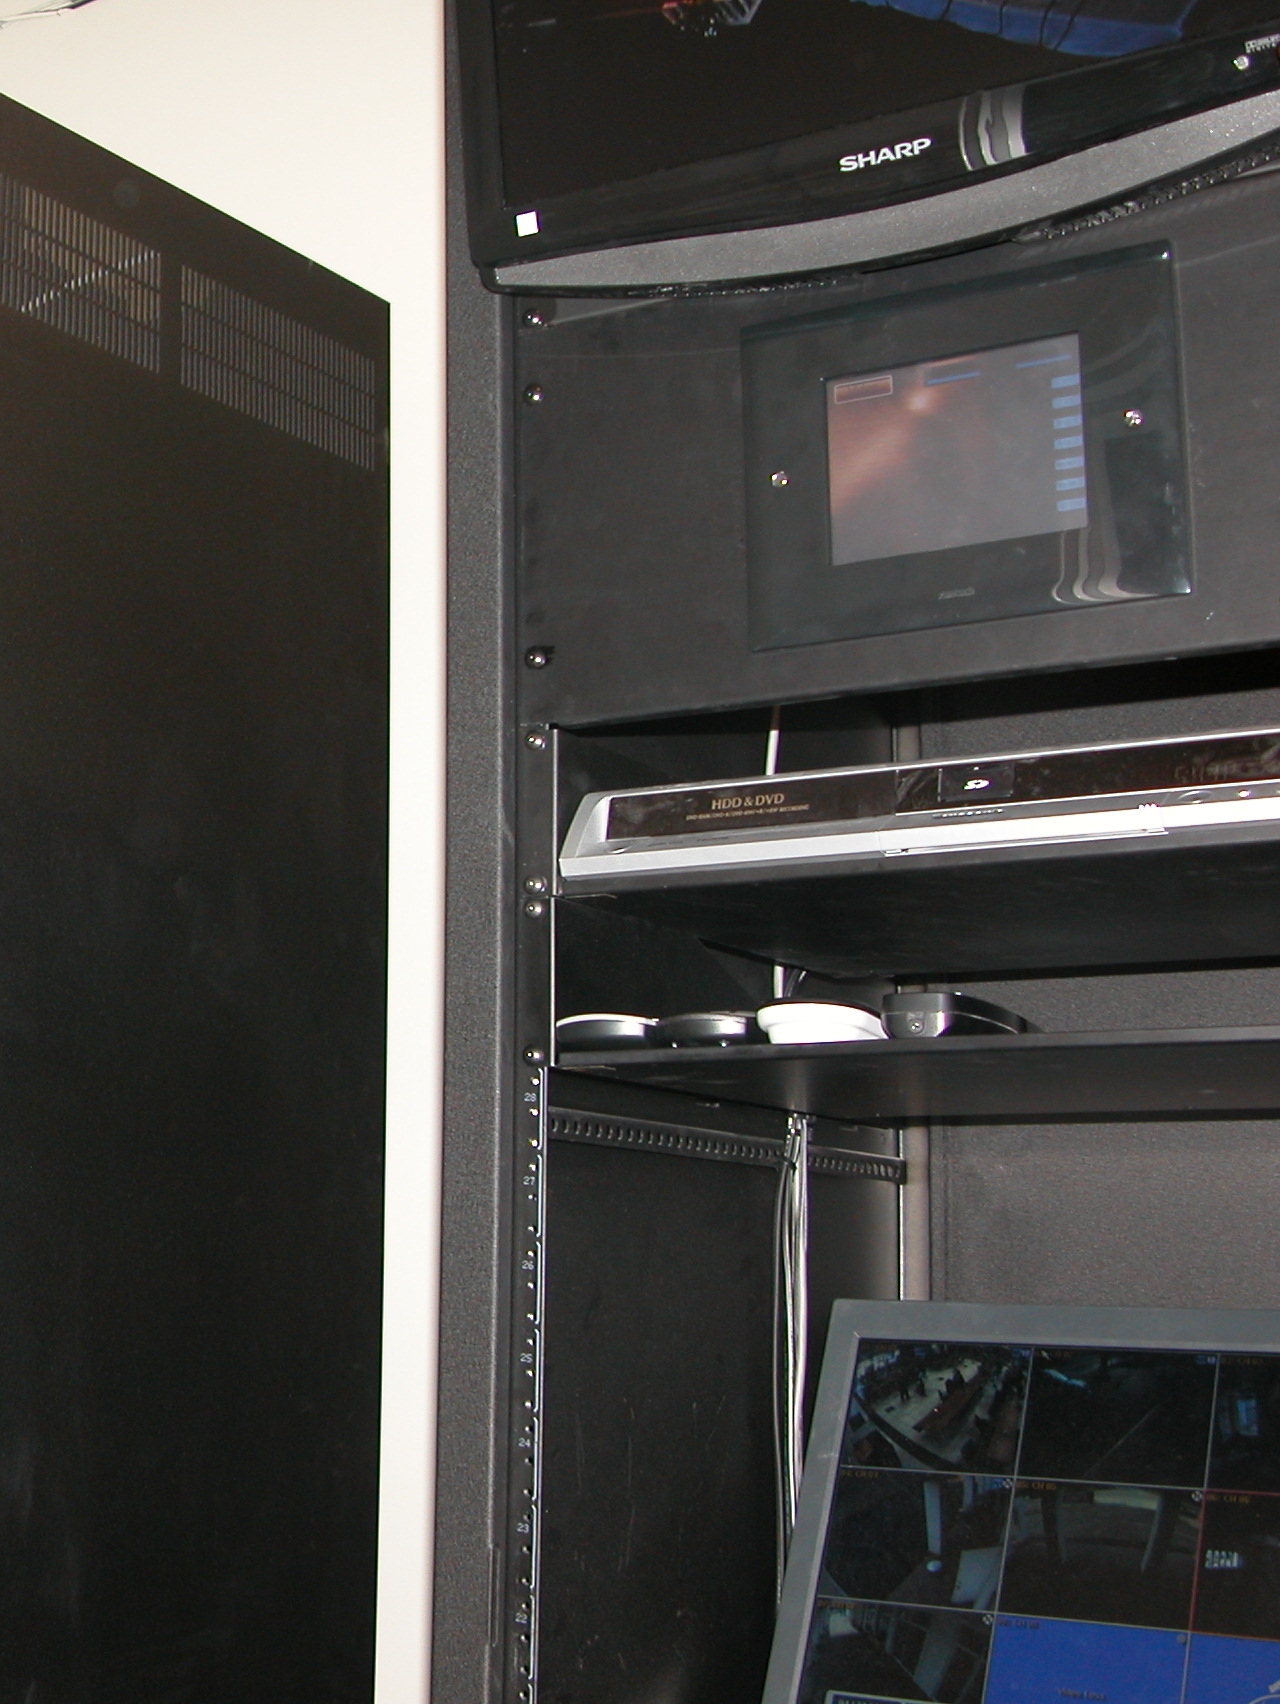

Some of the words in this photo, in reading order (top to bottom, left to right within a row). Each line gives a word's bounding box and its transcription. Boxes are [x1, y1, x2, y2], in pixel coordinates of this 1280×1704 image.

[839, 138, 932, 172] SHARP
[711, 797, 742, 810] HDD
[743, 796, 753, 806] &
[755, 793, 785, 806] DVD
[524, 1092, 537, 1102] 28
[523, 1176, 535, 1186] 27
[521, 1260, 534, 1270] 26
[518, 1438, 531, 1448] 24
[516, 1523, 529, 1533] 23
[515, 1612, 528, 1624] 22
